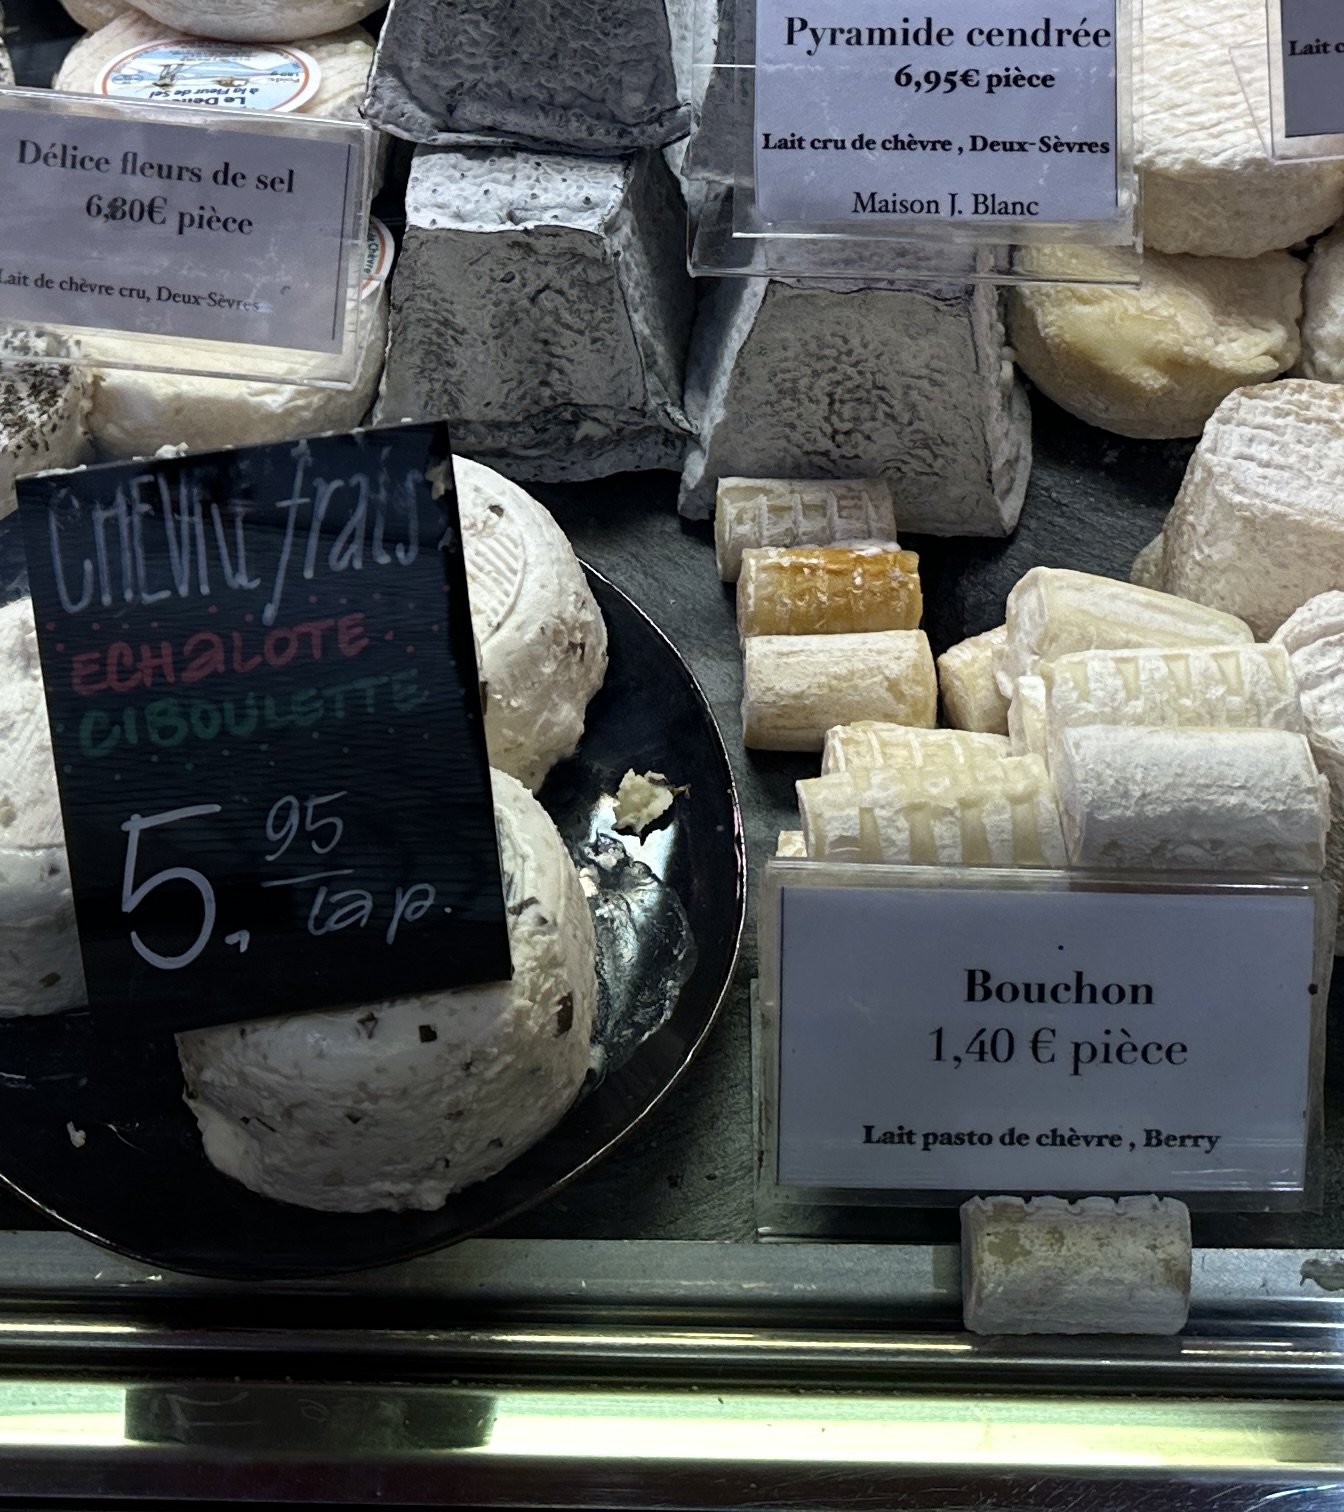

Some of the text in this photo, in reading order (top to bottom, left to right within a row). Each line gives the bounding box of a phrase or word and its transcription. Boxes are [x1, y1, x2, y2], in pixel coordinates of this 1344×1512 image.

[784, 15, 1112, 56] Pyramide cendrée
[894, 63, 1056, 95] 6,95€ pièce
[762, 131, 1111, 155] Lait cru de chèvre Deux-Sèvres
[18, 138, 295, 194] Délice fleurs de sel
[177, 206, 255, 236] pièce
[852, 191, 1040, 218] Maison J. Blanc
[78, 668, 430, 758] CIBOULETTE
[264, 790, 348, 863] 95
[963, 967, 1157, 1006] Bouchon
[927, 1025, 1190, 1077] 1,40 € pièce
[862, 1124, 1223, 1153] Lait pasto de chèvre Berry
